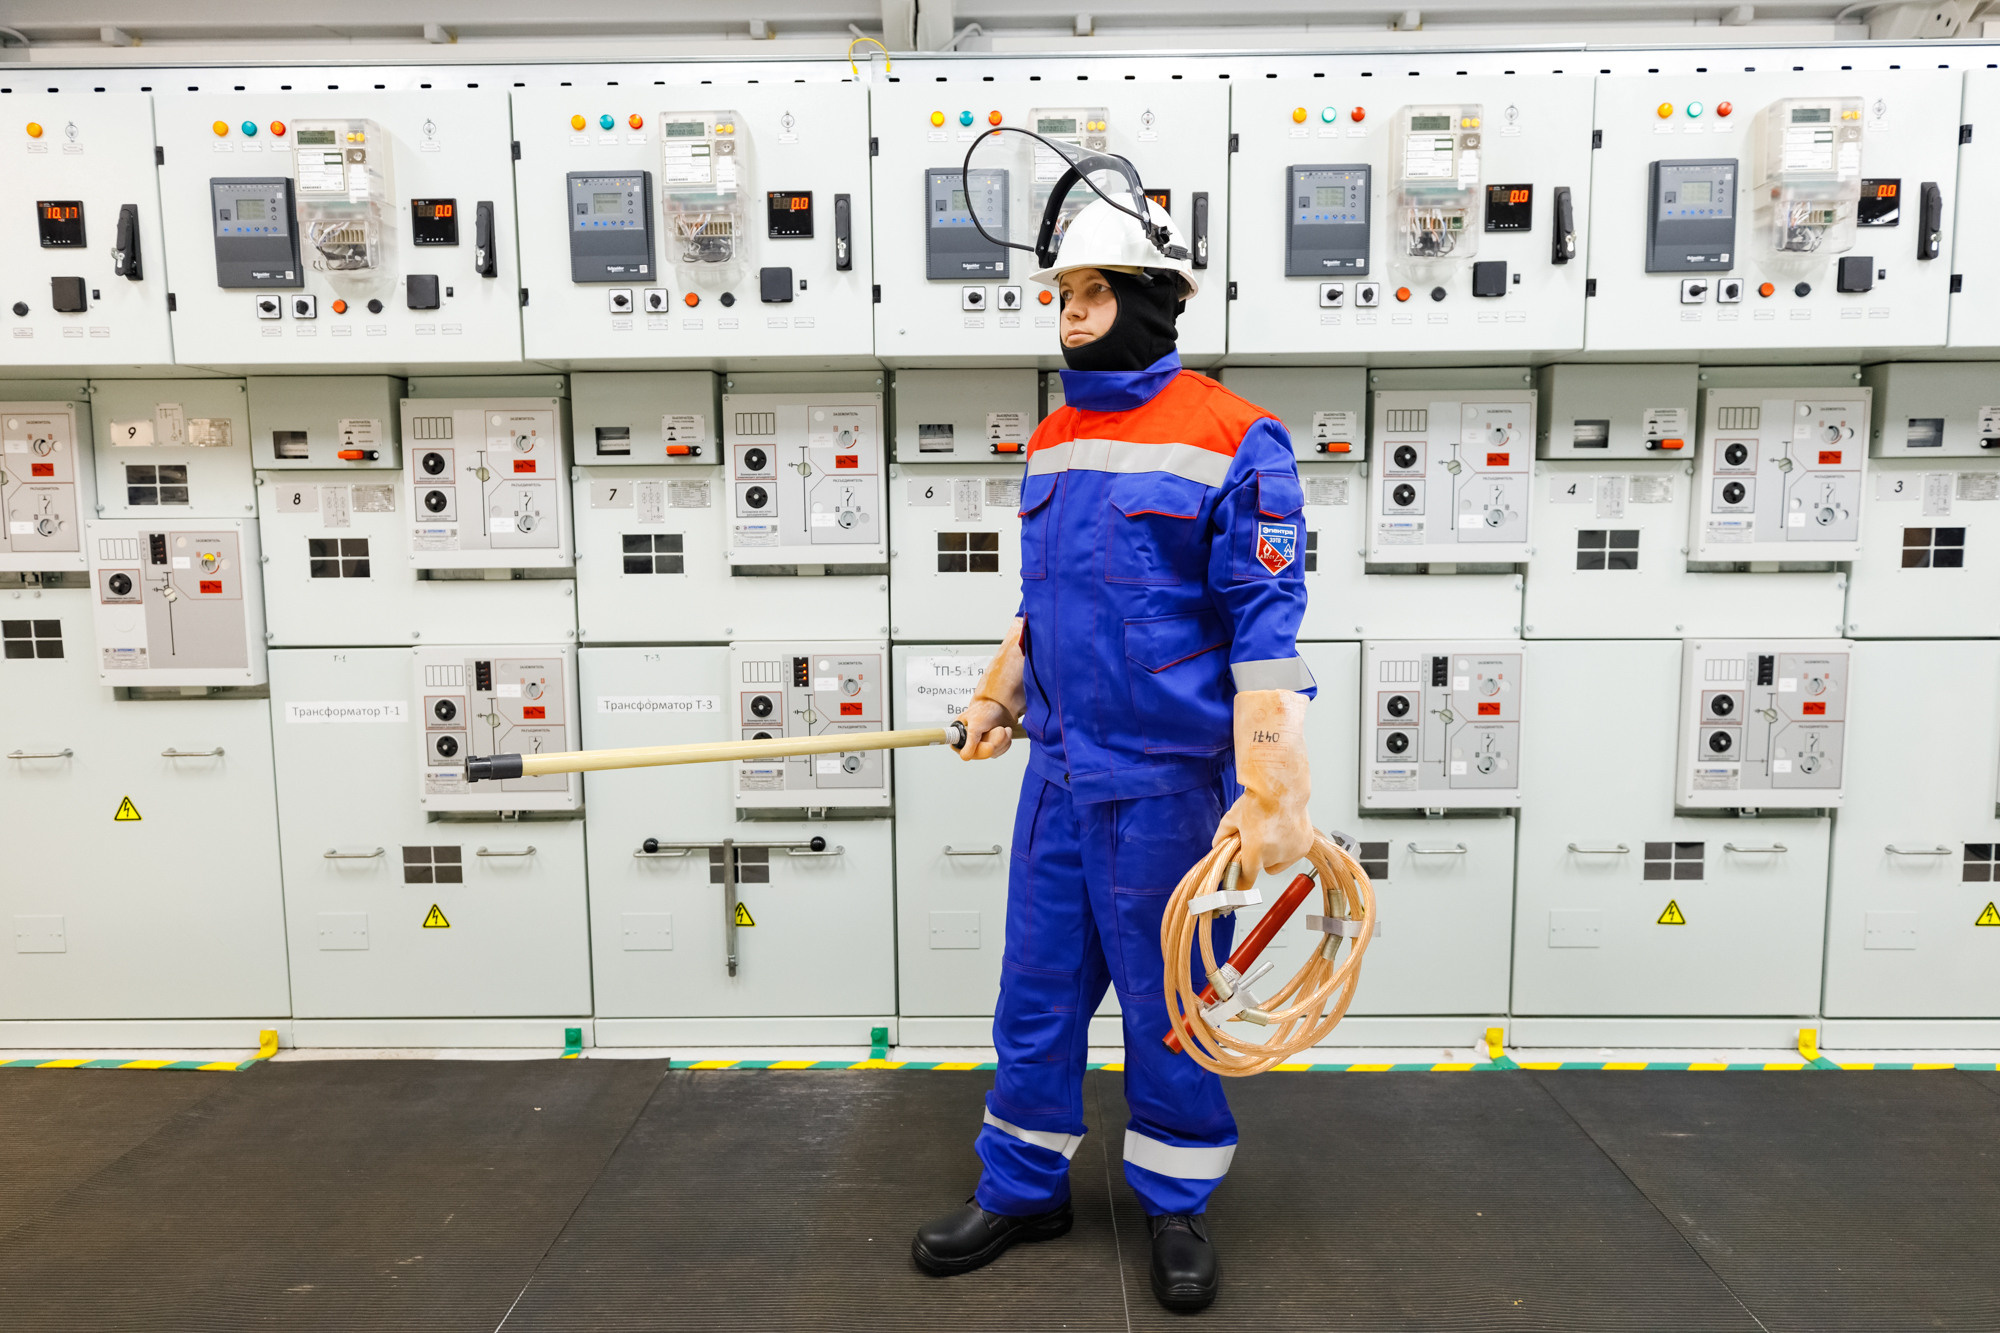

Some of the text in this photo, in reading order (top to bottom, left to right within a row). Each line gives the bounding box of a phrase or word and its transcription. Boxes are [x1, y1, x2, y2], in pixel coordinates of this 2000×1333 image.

[1509, 190, 1529, 203] 0.0
[1877, 185, 1897, 197] 0.0
[791, 197, 809, 210] 0.0
[1145, 195, 1167, 207] 17
[48, 207, 77, 219] 10.17
[435, 204, 452, 217] 0.0
[128, 427, 136, 439] 9
[925, 486, 934, 499] 6
[1567, 483, 1576, 495] 4
[1894, 480, 1903, 493] 3
[293, 493, 301, 505] 8
[609, 488, 617, 501] 7
[935, 666, 974, 676] ТП-5-1
[918, 685, 976, 696] Фармасинт
[604, 699, 713, 712] Трансформатор Т-3
[947, 704, 969, 715] Вво
[292, 706, 401, 718] Трансформатор Т-1
